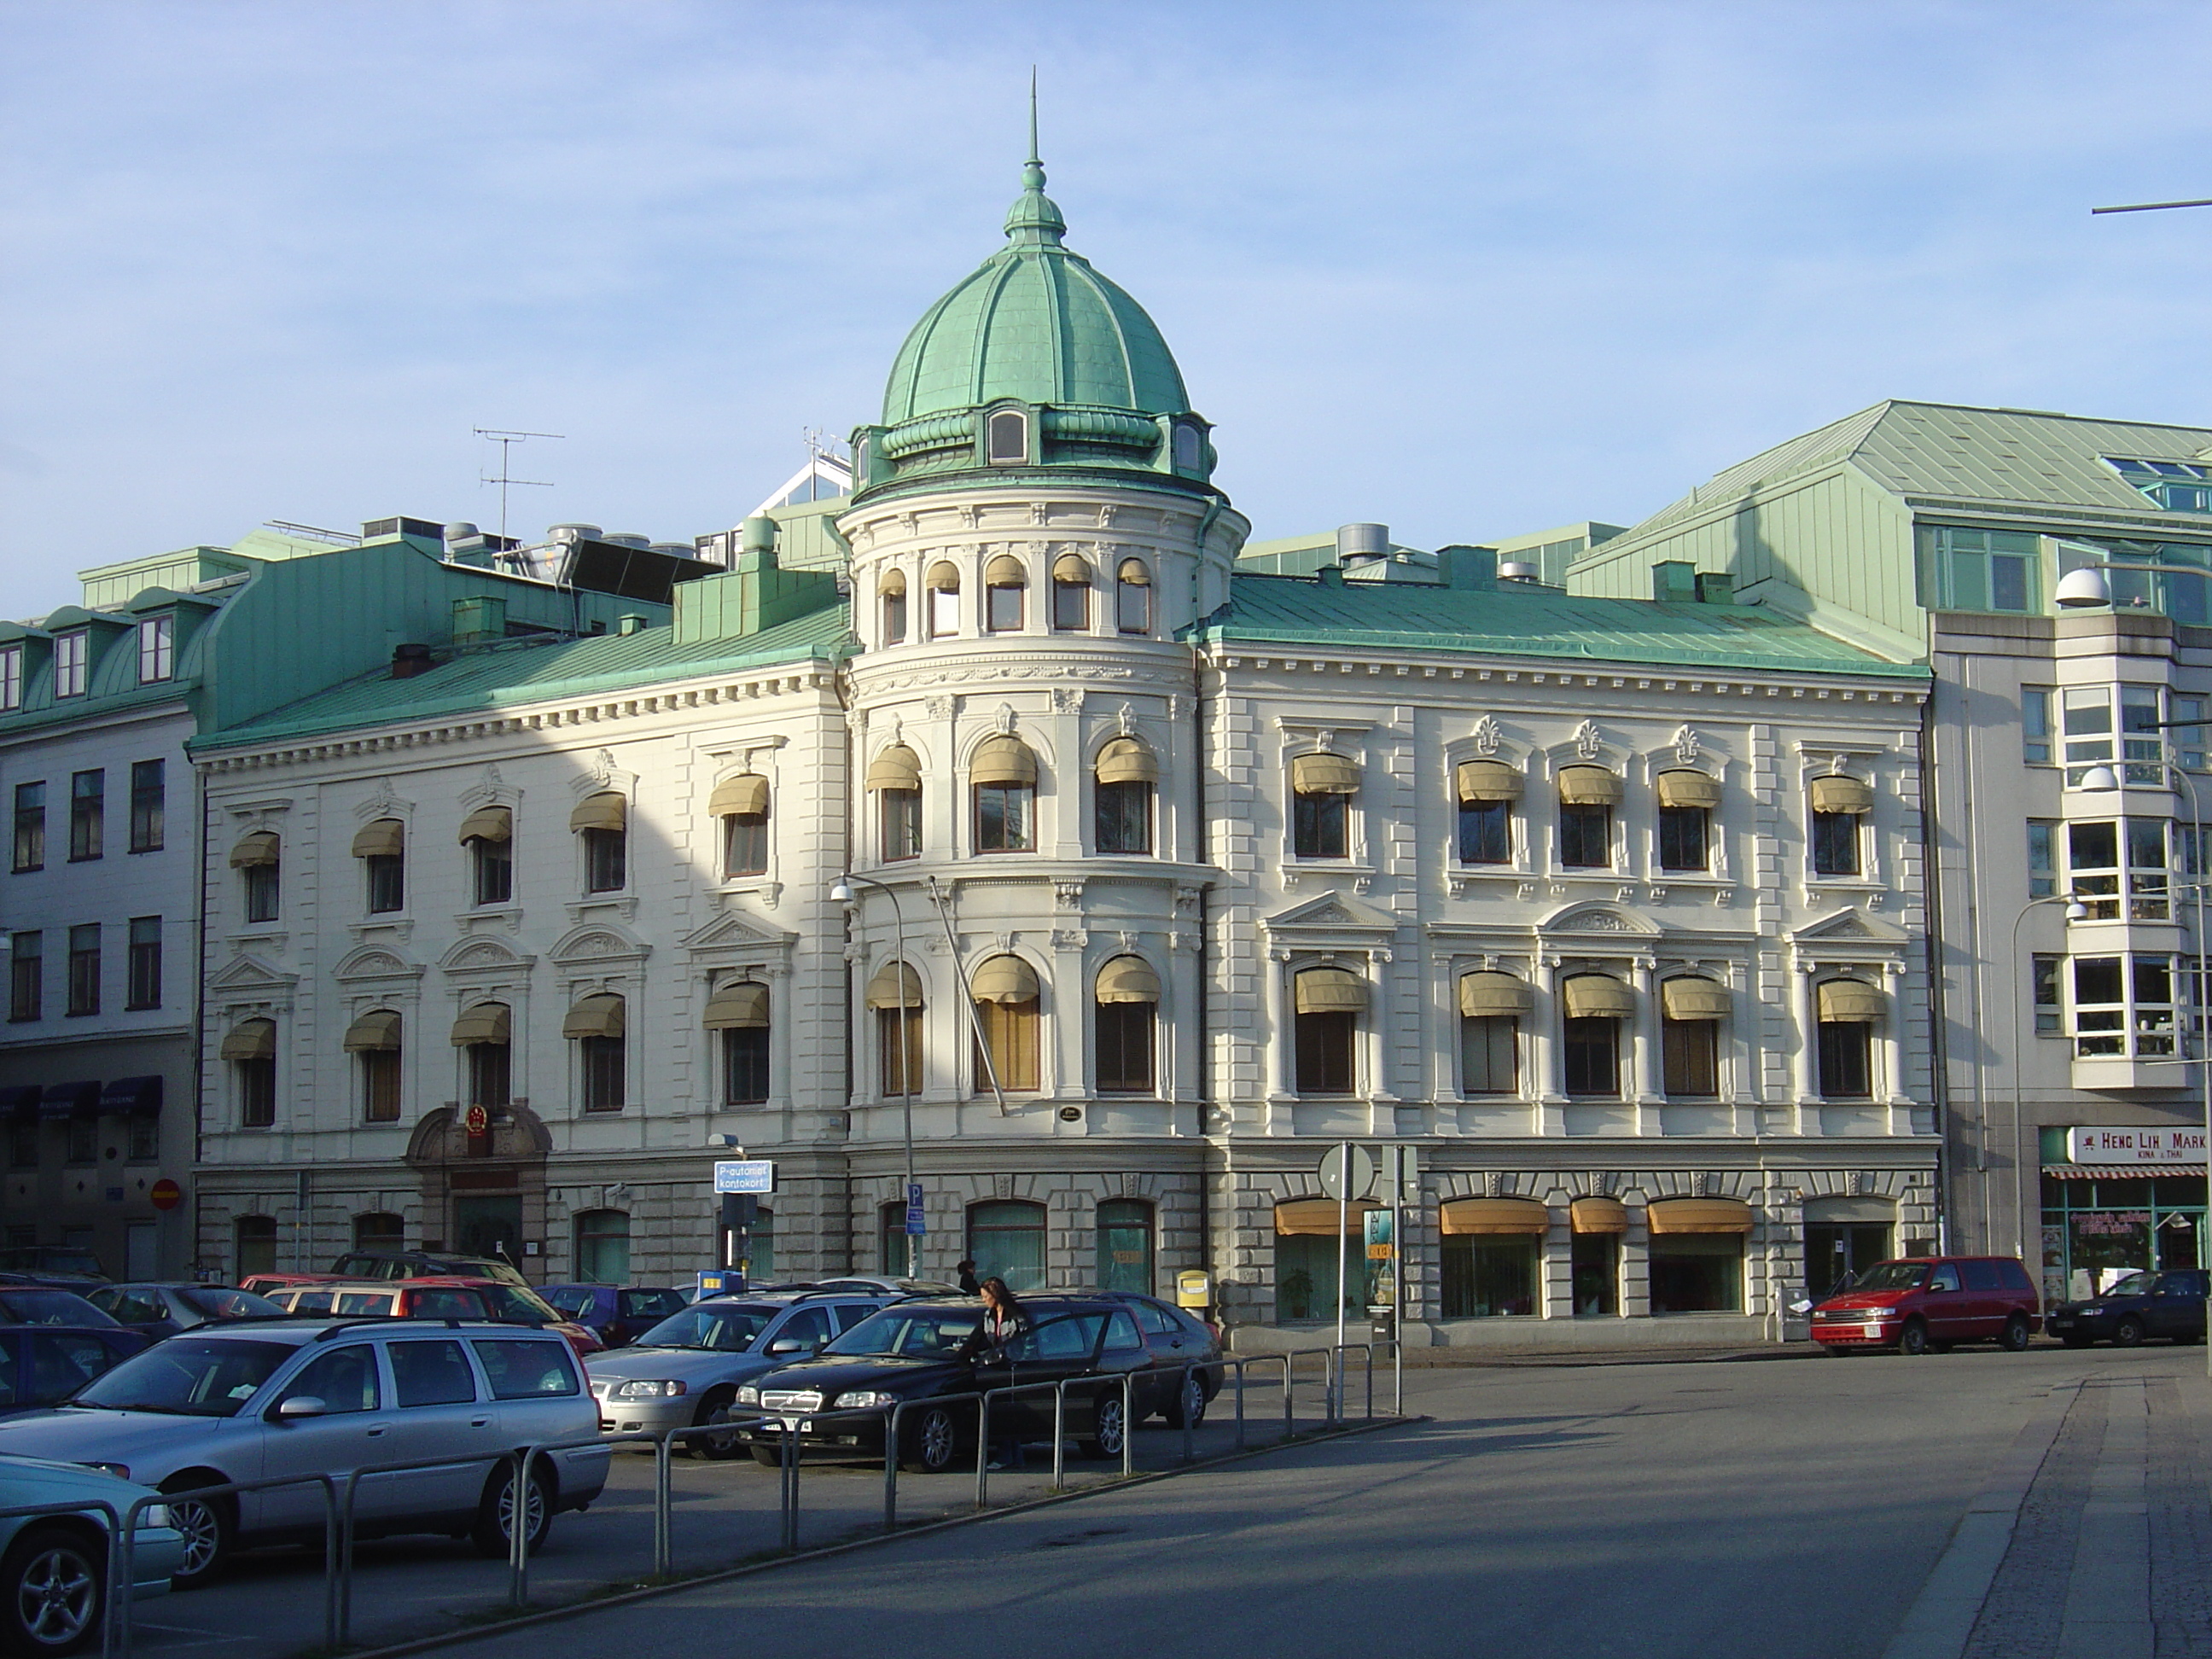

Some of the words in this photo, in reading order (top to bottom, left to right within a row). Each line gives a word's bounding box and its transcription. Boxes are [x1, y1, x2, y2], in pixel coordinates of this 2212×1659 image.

[2102, 1132, 2133, 1150] HENG
[2138, 1150, 2155, 1159] KINA
[2167, 1150, 2182, 1159] THAI
[911, 1185, 920, 1205] P
